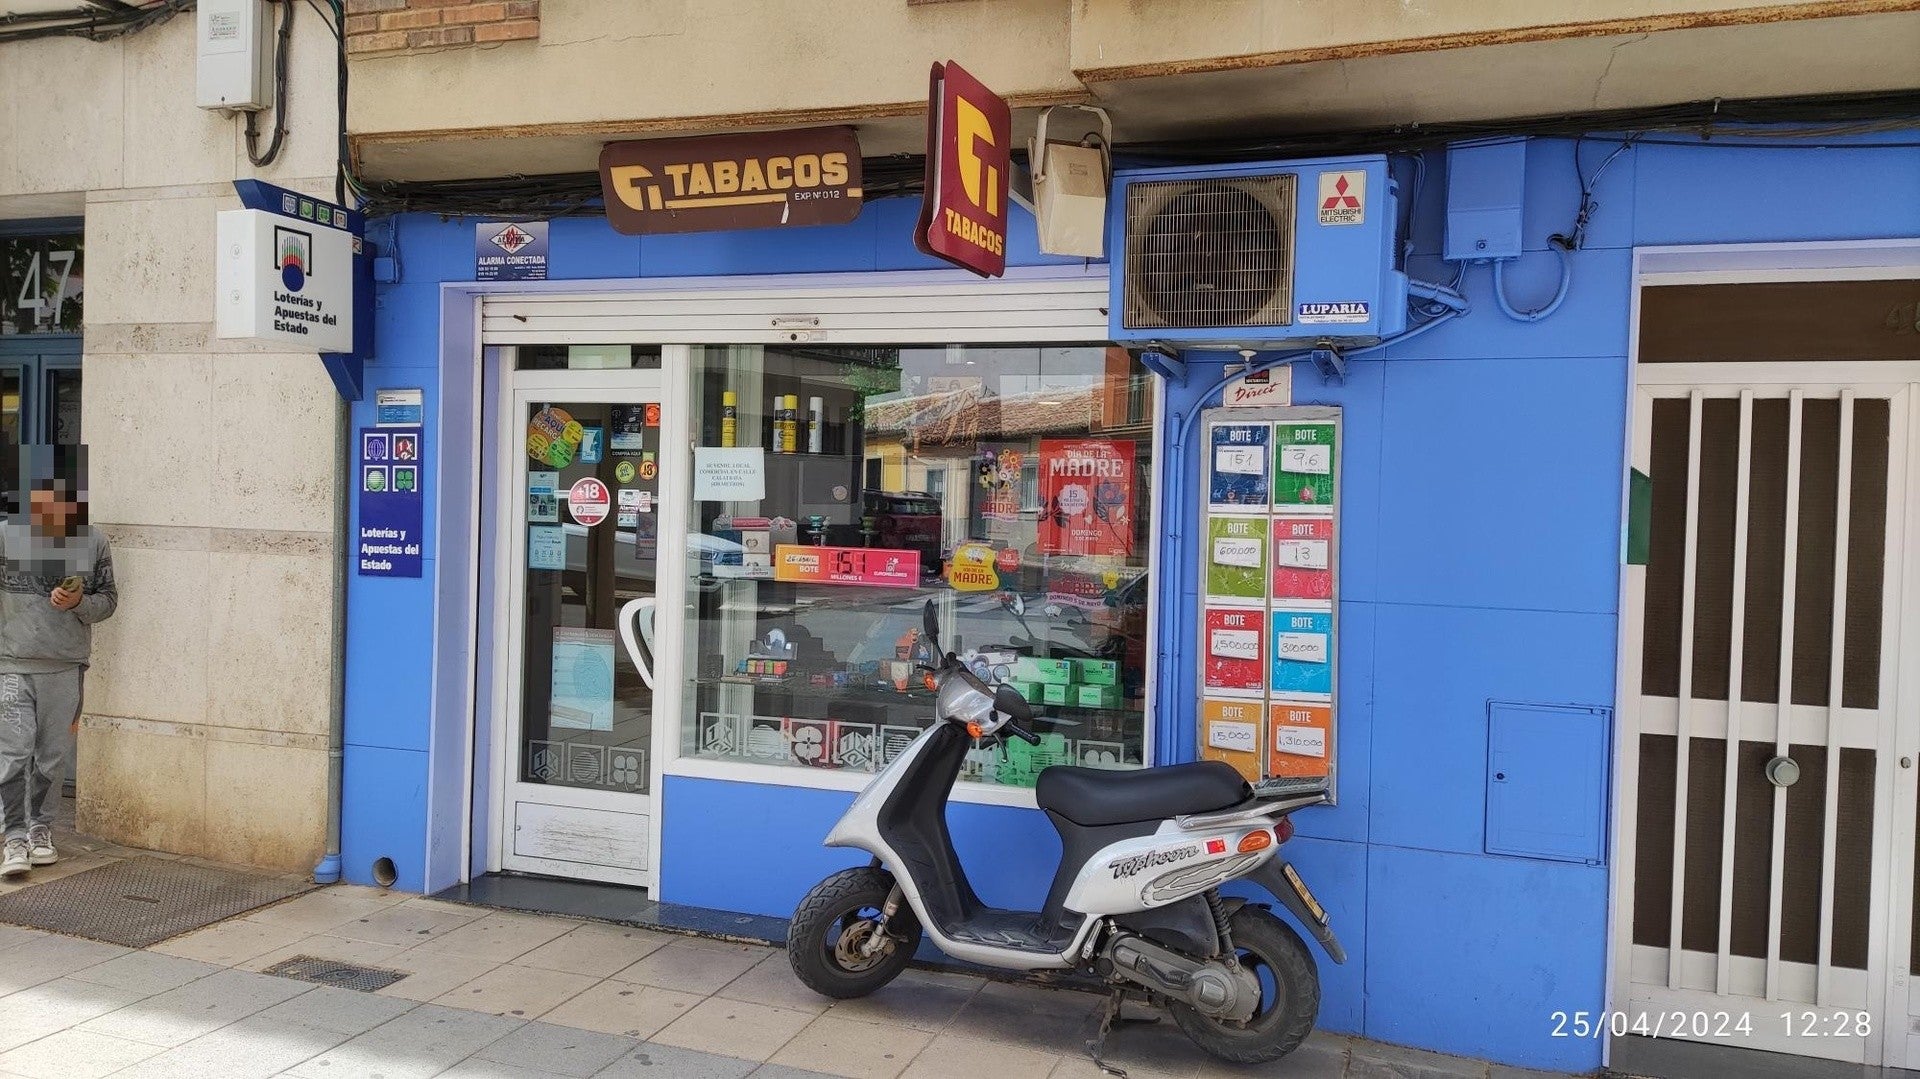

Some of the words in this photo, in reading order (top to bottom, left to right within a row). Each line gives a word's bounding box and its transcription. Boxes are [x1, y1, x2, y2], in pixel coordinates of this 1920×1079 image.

[664, 152, 849, 197] TABACOS
[822, 190, 840, 199] 012
[1320, 208, 1361, 216] MITSUBISHI
[1320, 215, 1356, 223] ELECTRIC
[945, 207, 1003, 256] TABACOS
[478, 256, 505, 266] ALARMA
[506, 255, 546, 265] CONECTADA
[18, 251, 76, 327] 47
[273, 290, 314, 308] Loterías
[316, 300, 323, 311] y
[1302, 303, 1366, 315] LUPARIA
[274, 305, 320, 323] Apuestas
[322, 313, 337, 326] del
[274, 319, 309, 335] Estado
[1235, 382, 1282, 402] Direct
[1230, 430, 1252, 442] BOTE
[1294, 429, 1317, 440] BOTE
[1050, 458, 1124, 478] MADRE
[576, 483, 600, 499] +18
[1068, 489, 1078, 498] 15
[361, 527, 398, 539] Loterías
[399, 530, 407, 541] y
[1071, 529, 1103, 537] DOMINGO
[1227, 522, 1249, 534] BOTE
[1291, 524, 1314, 535] BOTE
[361, 543, 403, 556] Apuestas
[404, 543, 420, 555] del
[1294, 546, 1311, 562] 13
[361, 559, 392, 570] Estado
[799, 565, 820, 573] BOTE
[953, 571, 993, 585] MADRE
[1223, 614, 1246, 626] BOTE
[1291, 617, 1313, 628] BOTE
[1222, 706, 1244, 717] BOTE
[1289, 710, 1312, 722] BOTE
[1109, 843, 1200, 879] Typhoon
